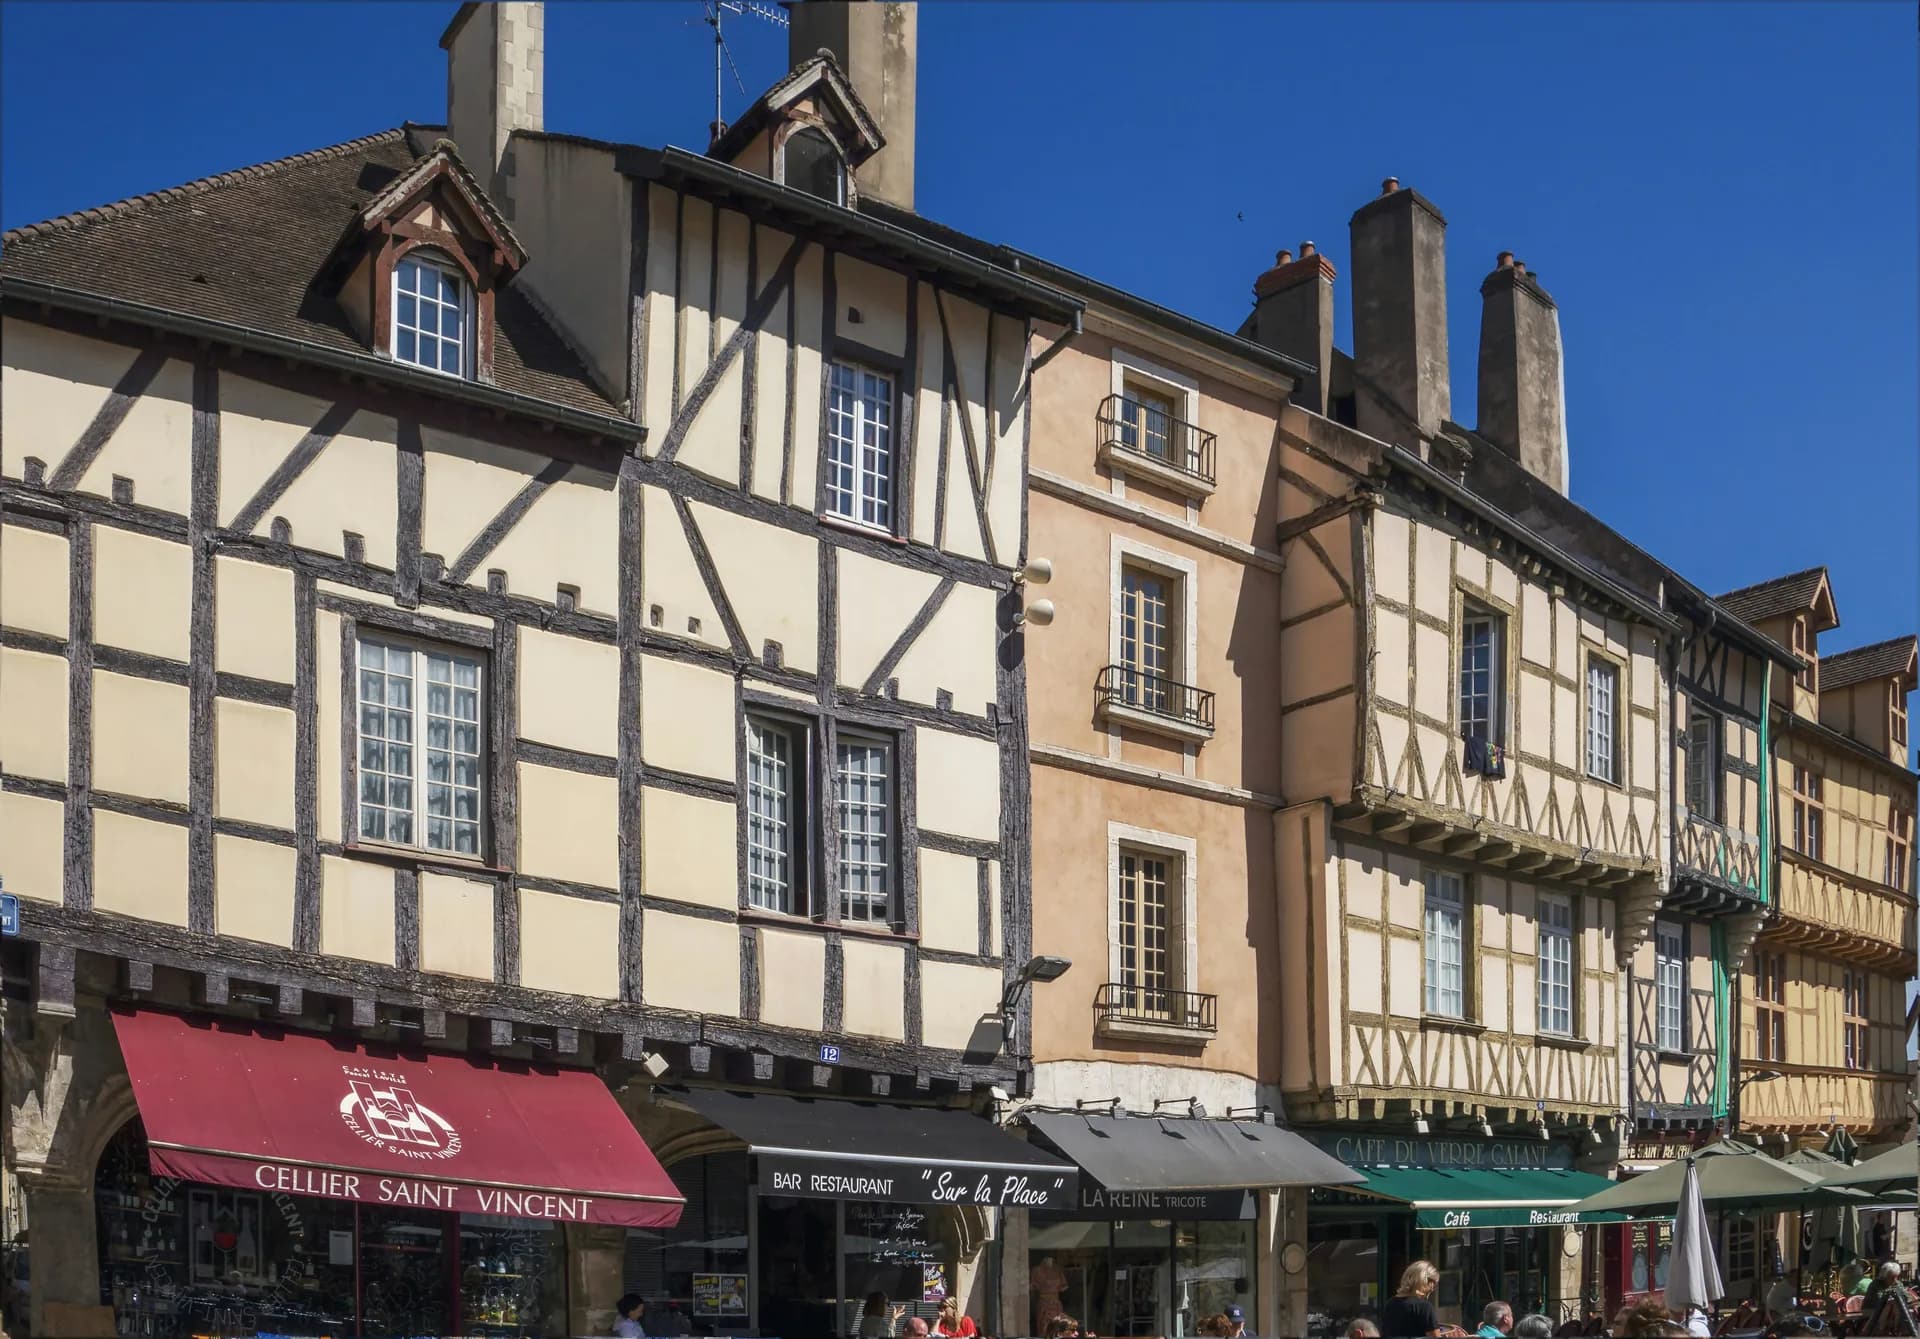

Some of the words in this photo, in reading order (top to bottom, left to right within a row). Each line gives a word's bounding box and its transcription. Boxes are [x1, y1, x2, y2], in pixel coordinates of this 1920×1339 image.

[823, 1047, 837, 1061] 12
[341, 1113, 385, 1149] CELLIER
[388, 1145, 433, 1160] SAINT
[432, 1131, 462, 1160] VINCENT
[1394, 1139, 1419, 1163] DU
[1426, 1142, 1485, 1165] VERRE
[1490, 1143, 1549, 1166] GALANT
[255, 1165, 361, 1199] CELLIER
[378, 1179, 459, 1208] SAINT
[475, 1188, 593, 1220] VINCENT
[773, 1172, 801, 1190] BAR
[810, 1174, 894, 1195] RESTAURANT
[974, 1174, 991, 1203] la
[1082, 1187, 1105, 1208] LA
[1109, 1191, 1161, 1208] REINE
[1164, 1196, 1207, 1208] TRICOTE
[1444, 1211, 1471, 1227] Café
[1529, 1210, 1580, 1225] Restaurant
